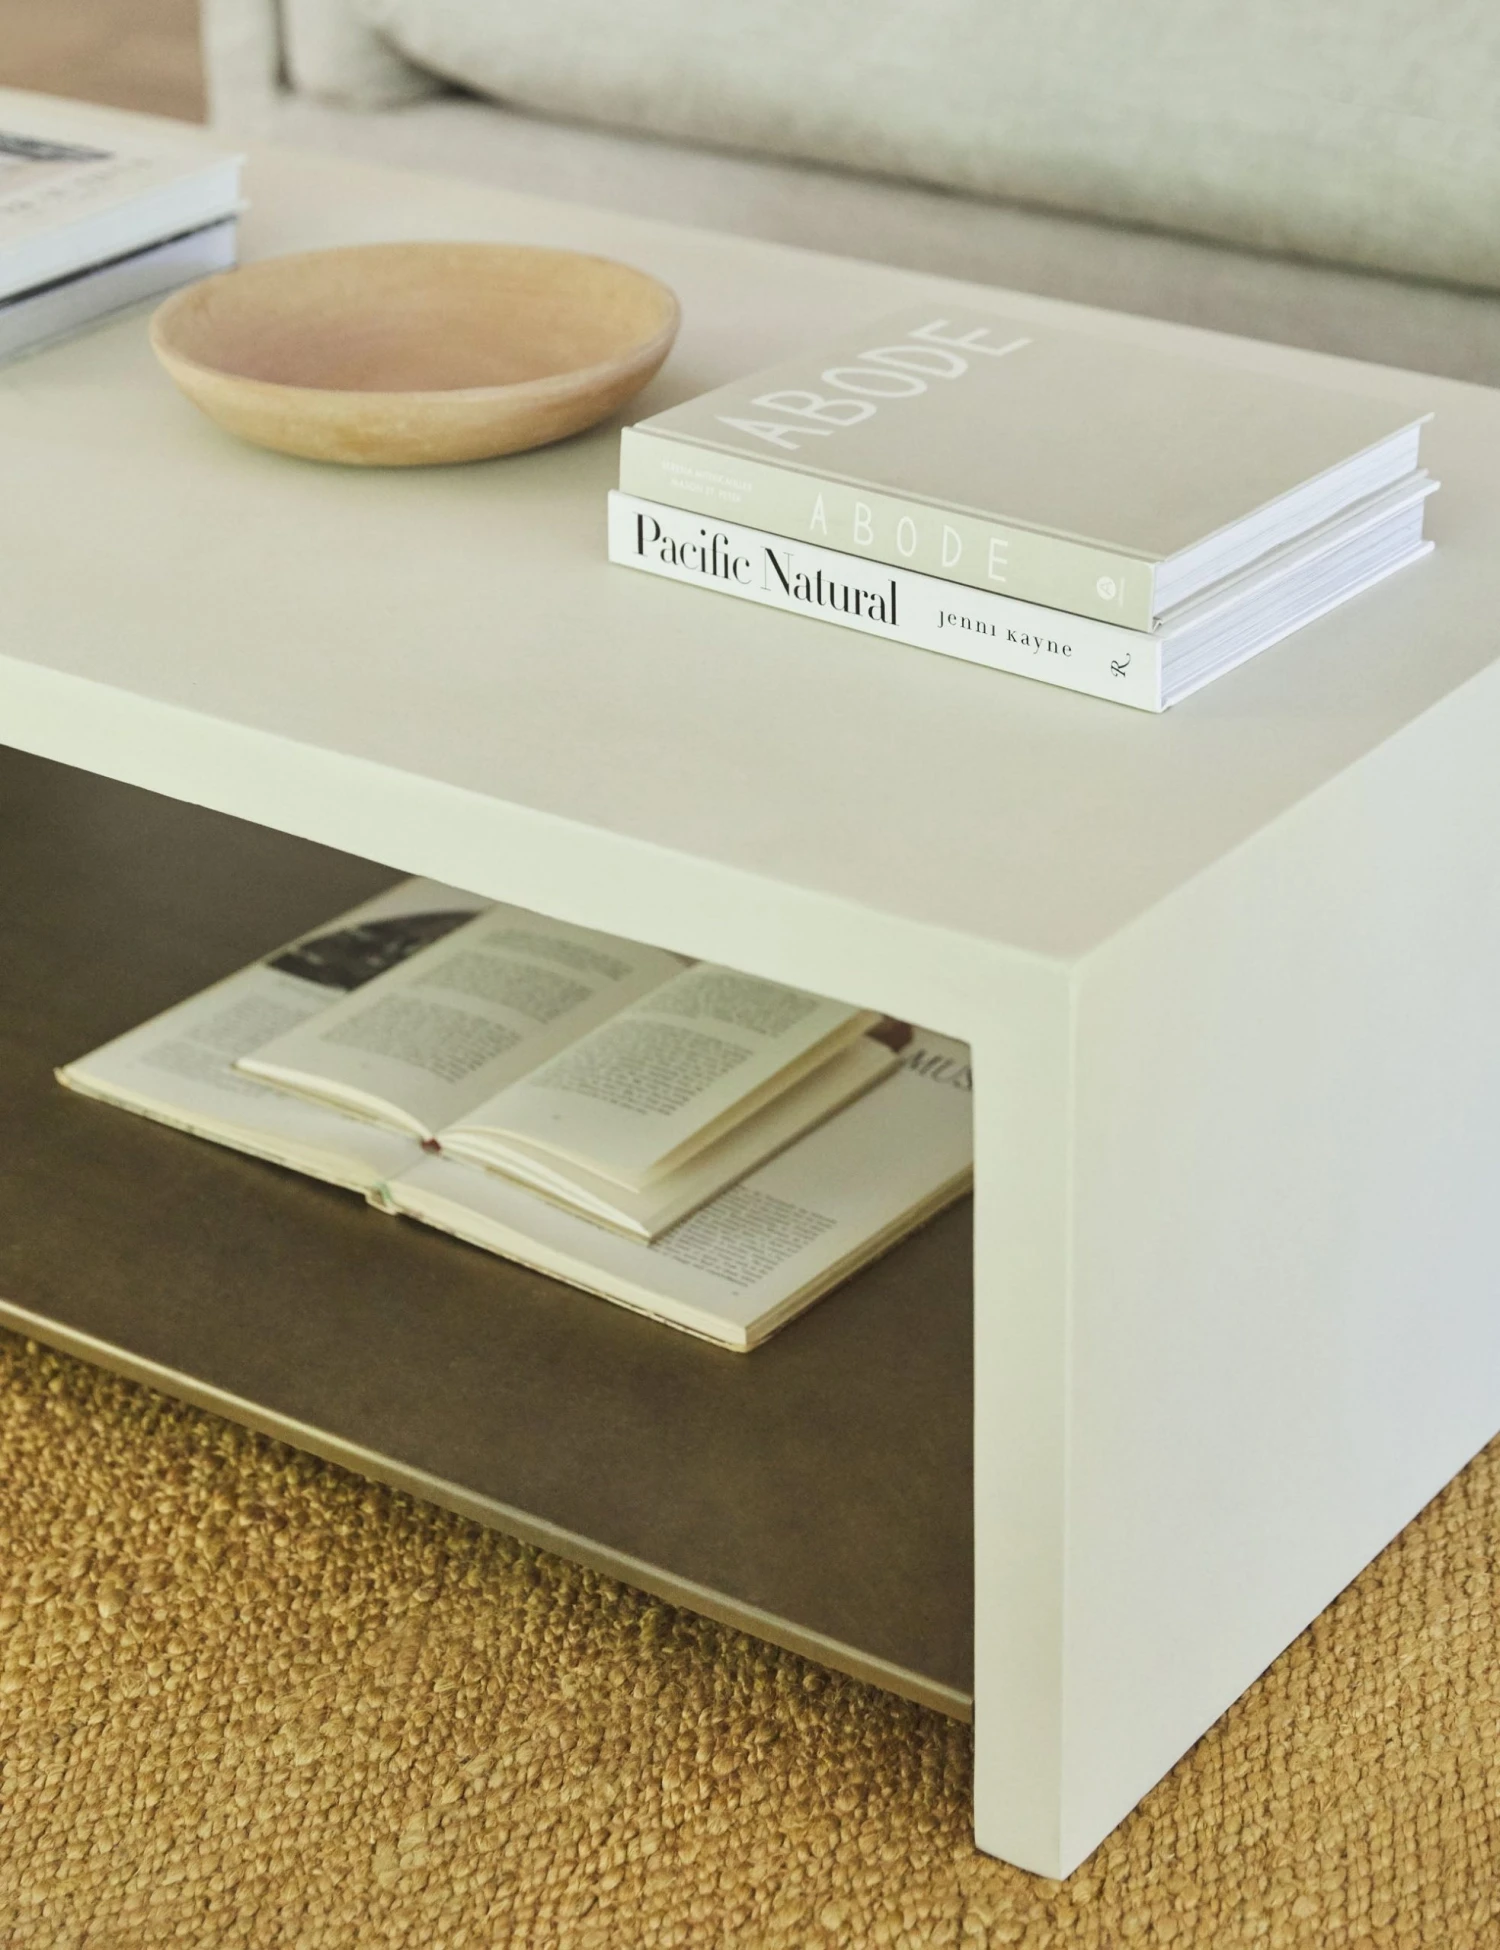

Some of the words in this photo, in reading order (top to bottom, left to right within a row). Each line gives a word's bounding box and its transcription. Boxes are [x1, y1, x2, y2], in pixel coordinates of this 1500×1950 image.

[714, 319, 1033, 450] ABODE
[633, 511, 752, 584] Pacific
[760, 546, 900, 626] Natural
[810, 492, 1009, 582] ABODE
